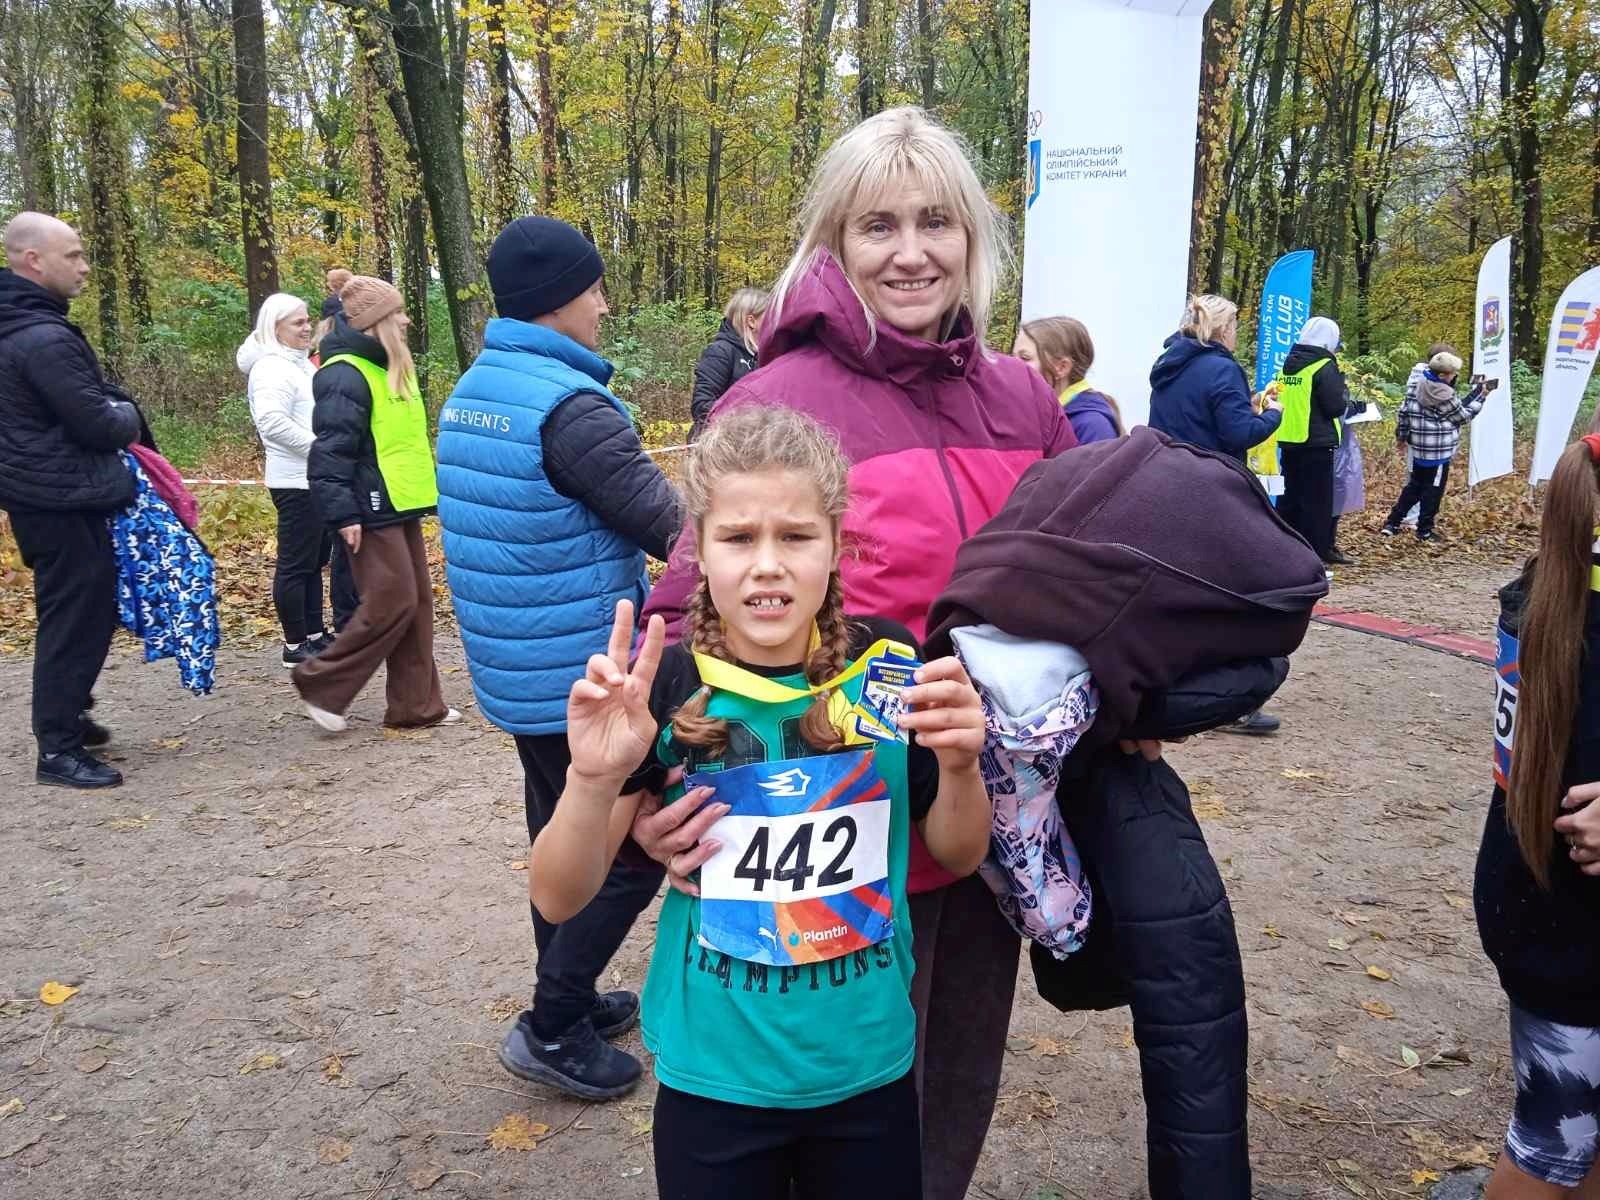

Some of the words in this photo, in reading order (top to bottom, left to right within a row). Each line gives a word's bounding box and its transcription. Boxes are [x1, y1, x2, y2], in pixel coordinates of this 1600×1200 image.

[1046, 145, 1123, 158] НАЦІОНАЛЬНИЙ
[1046, 156, 1118, 169] ОЛІМПІЙСЬКИЙ
[1046, 171, 1080, 180] КОМІТЕТ
[1275, 294, 1293, 346] CLUB
[460, 409, 511, 433] EVENTS
[1495, 678, 1517, 738] 5
[734, 815, 858, 892] 442
[803, 924, 848, 944] Plantin
